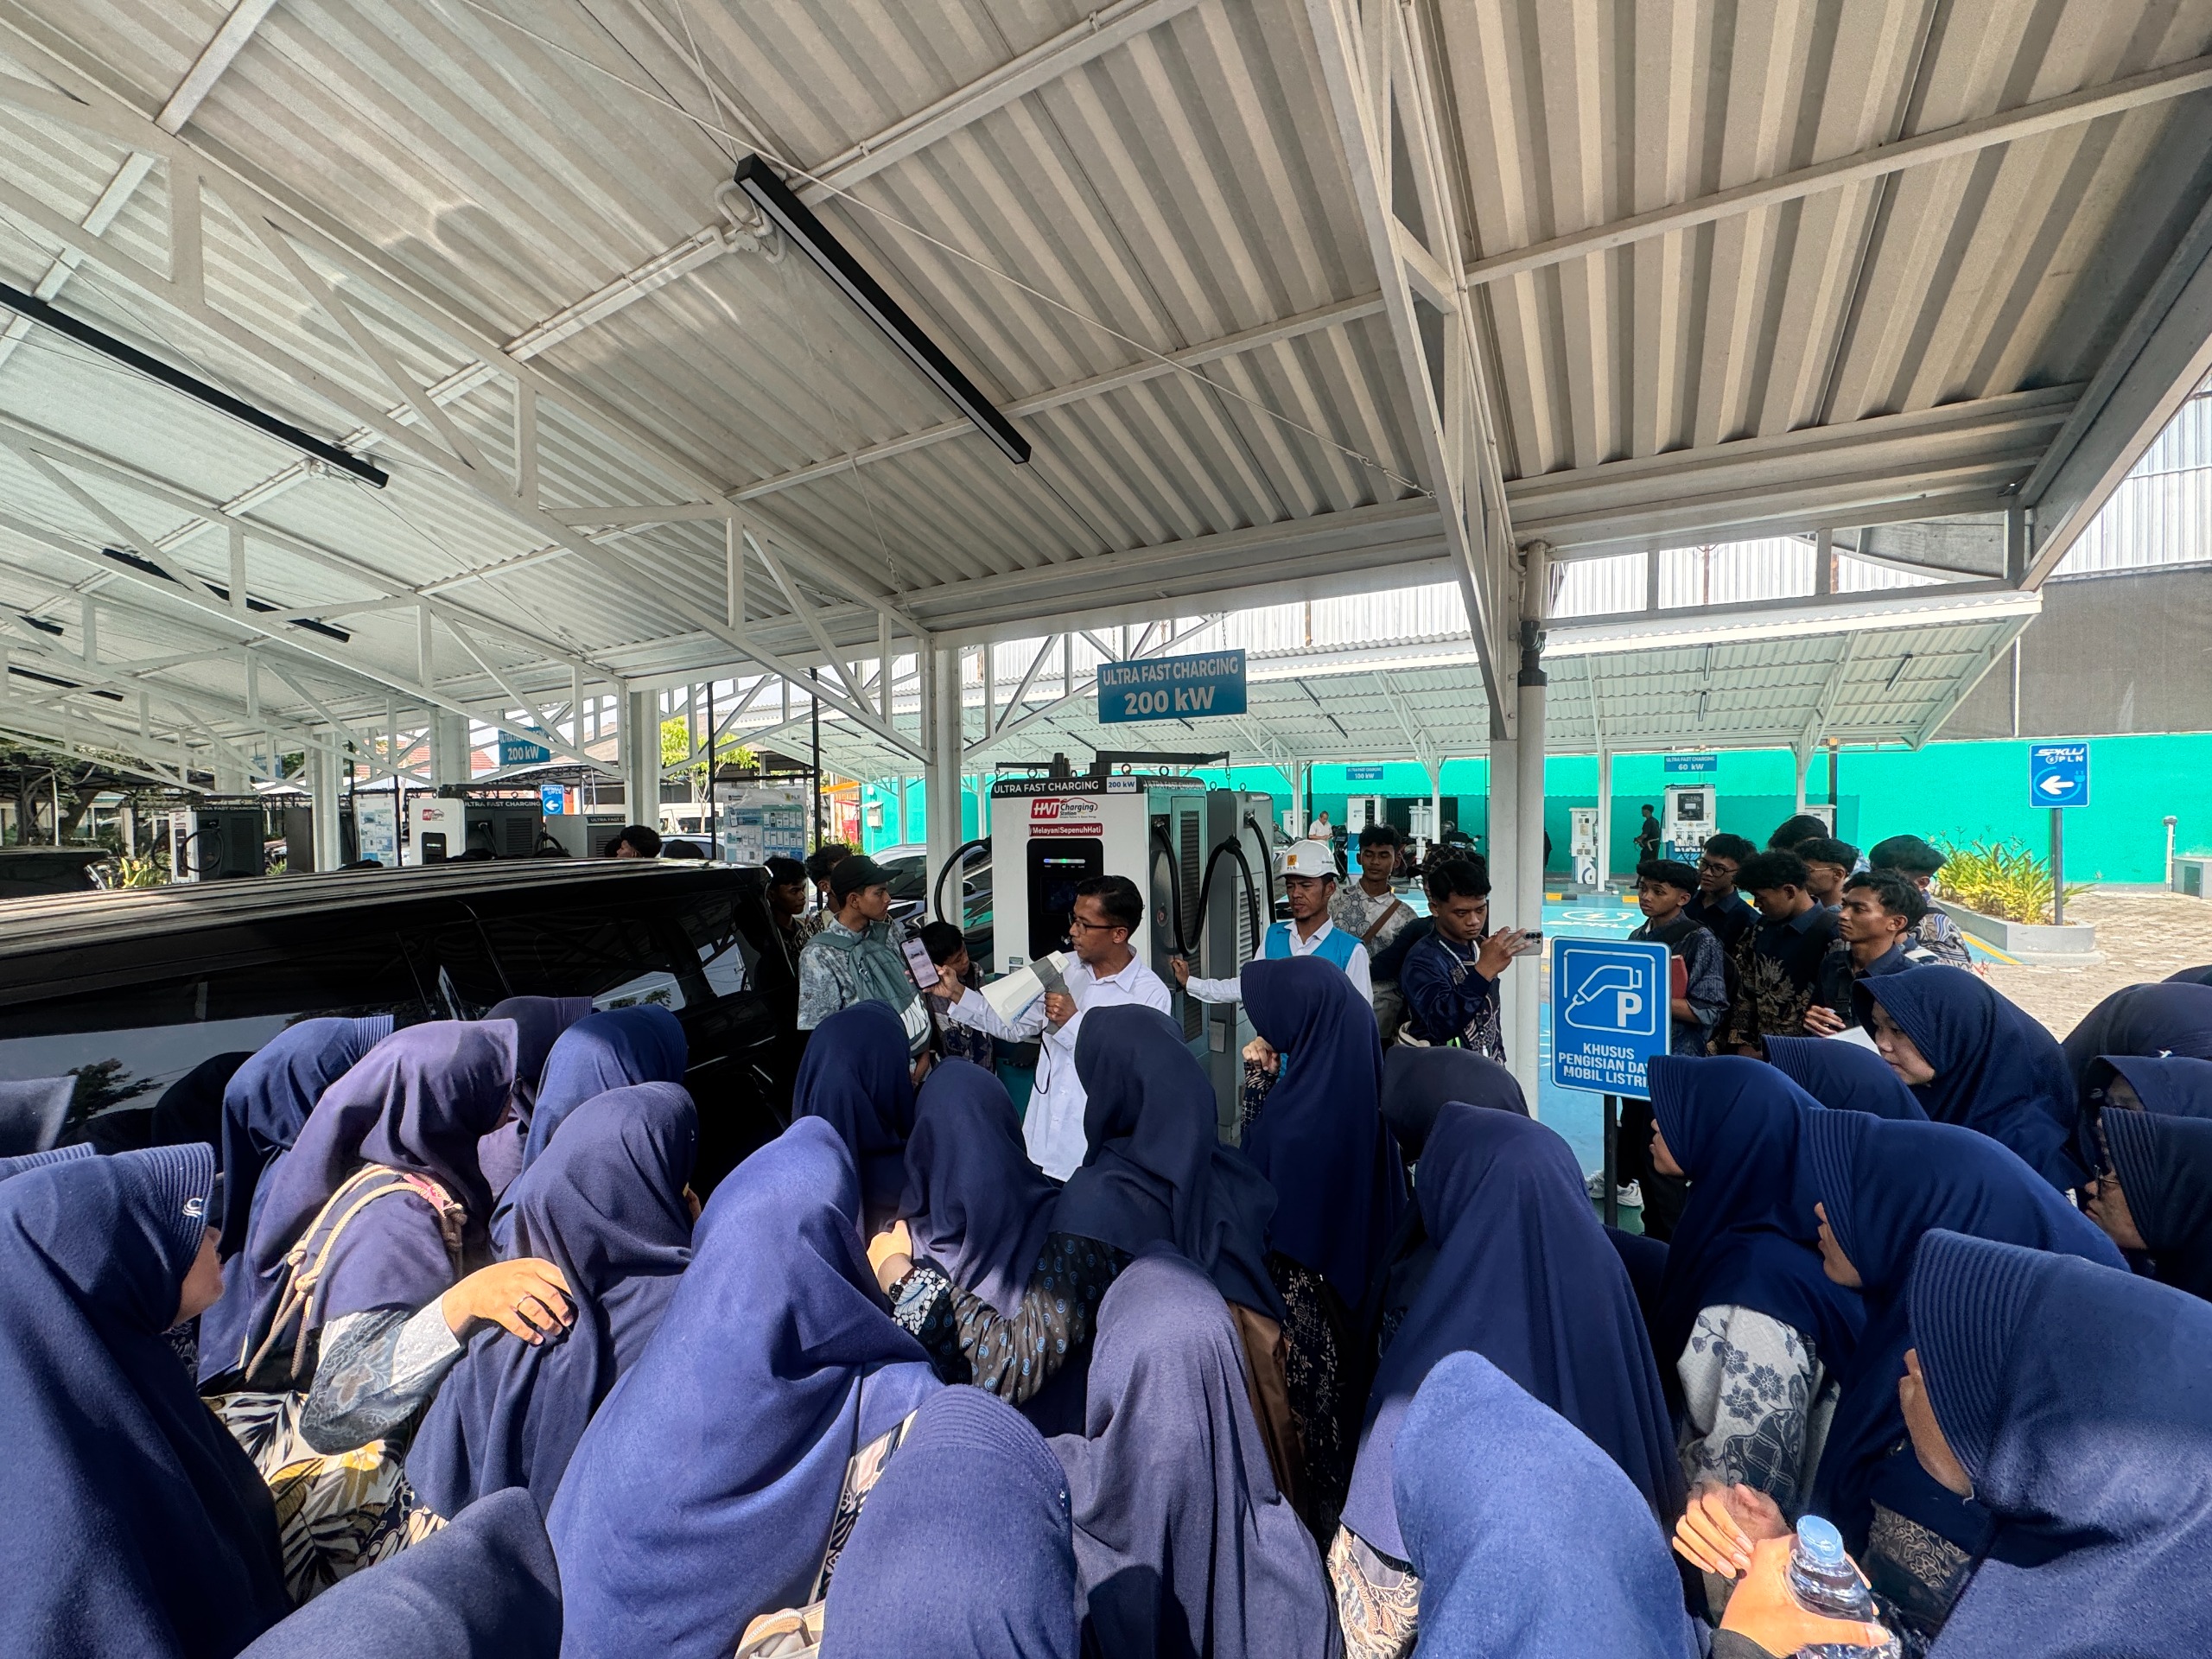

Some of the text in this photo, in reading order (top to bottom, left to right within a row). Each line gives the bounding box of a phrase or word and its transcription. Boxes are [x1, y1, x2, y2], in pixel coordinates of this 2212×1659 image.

[1103, 656, 1239, 685] ULTRA FAST CHARGING
[1124, 686, 1216, 715] 200 kW
[507, 746, 539, 760] 200 kW
[995, 780, 1099, 794] ULTRA FAST CHARGING
[1060, 803, 1094, 812] Charging
[1617, 991, 1643, 1027] P
[1583, 1042, 1635, 1060] KHUSUS
[1558, 1052, 1624, 1071] PENGISIAN
[1563, 1065, 1649, 1088] MOBIL LISTRI
